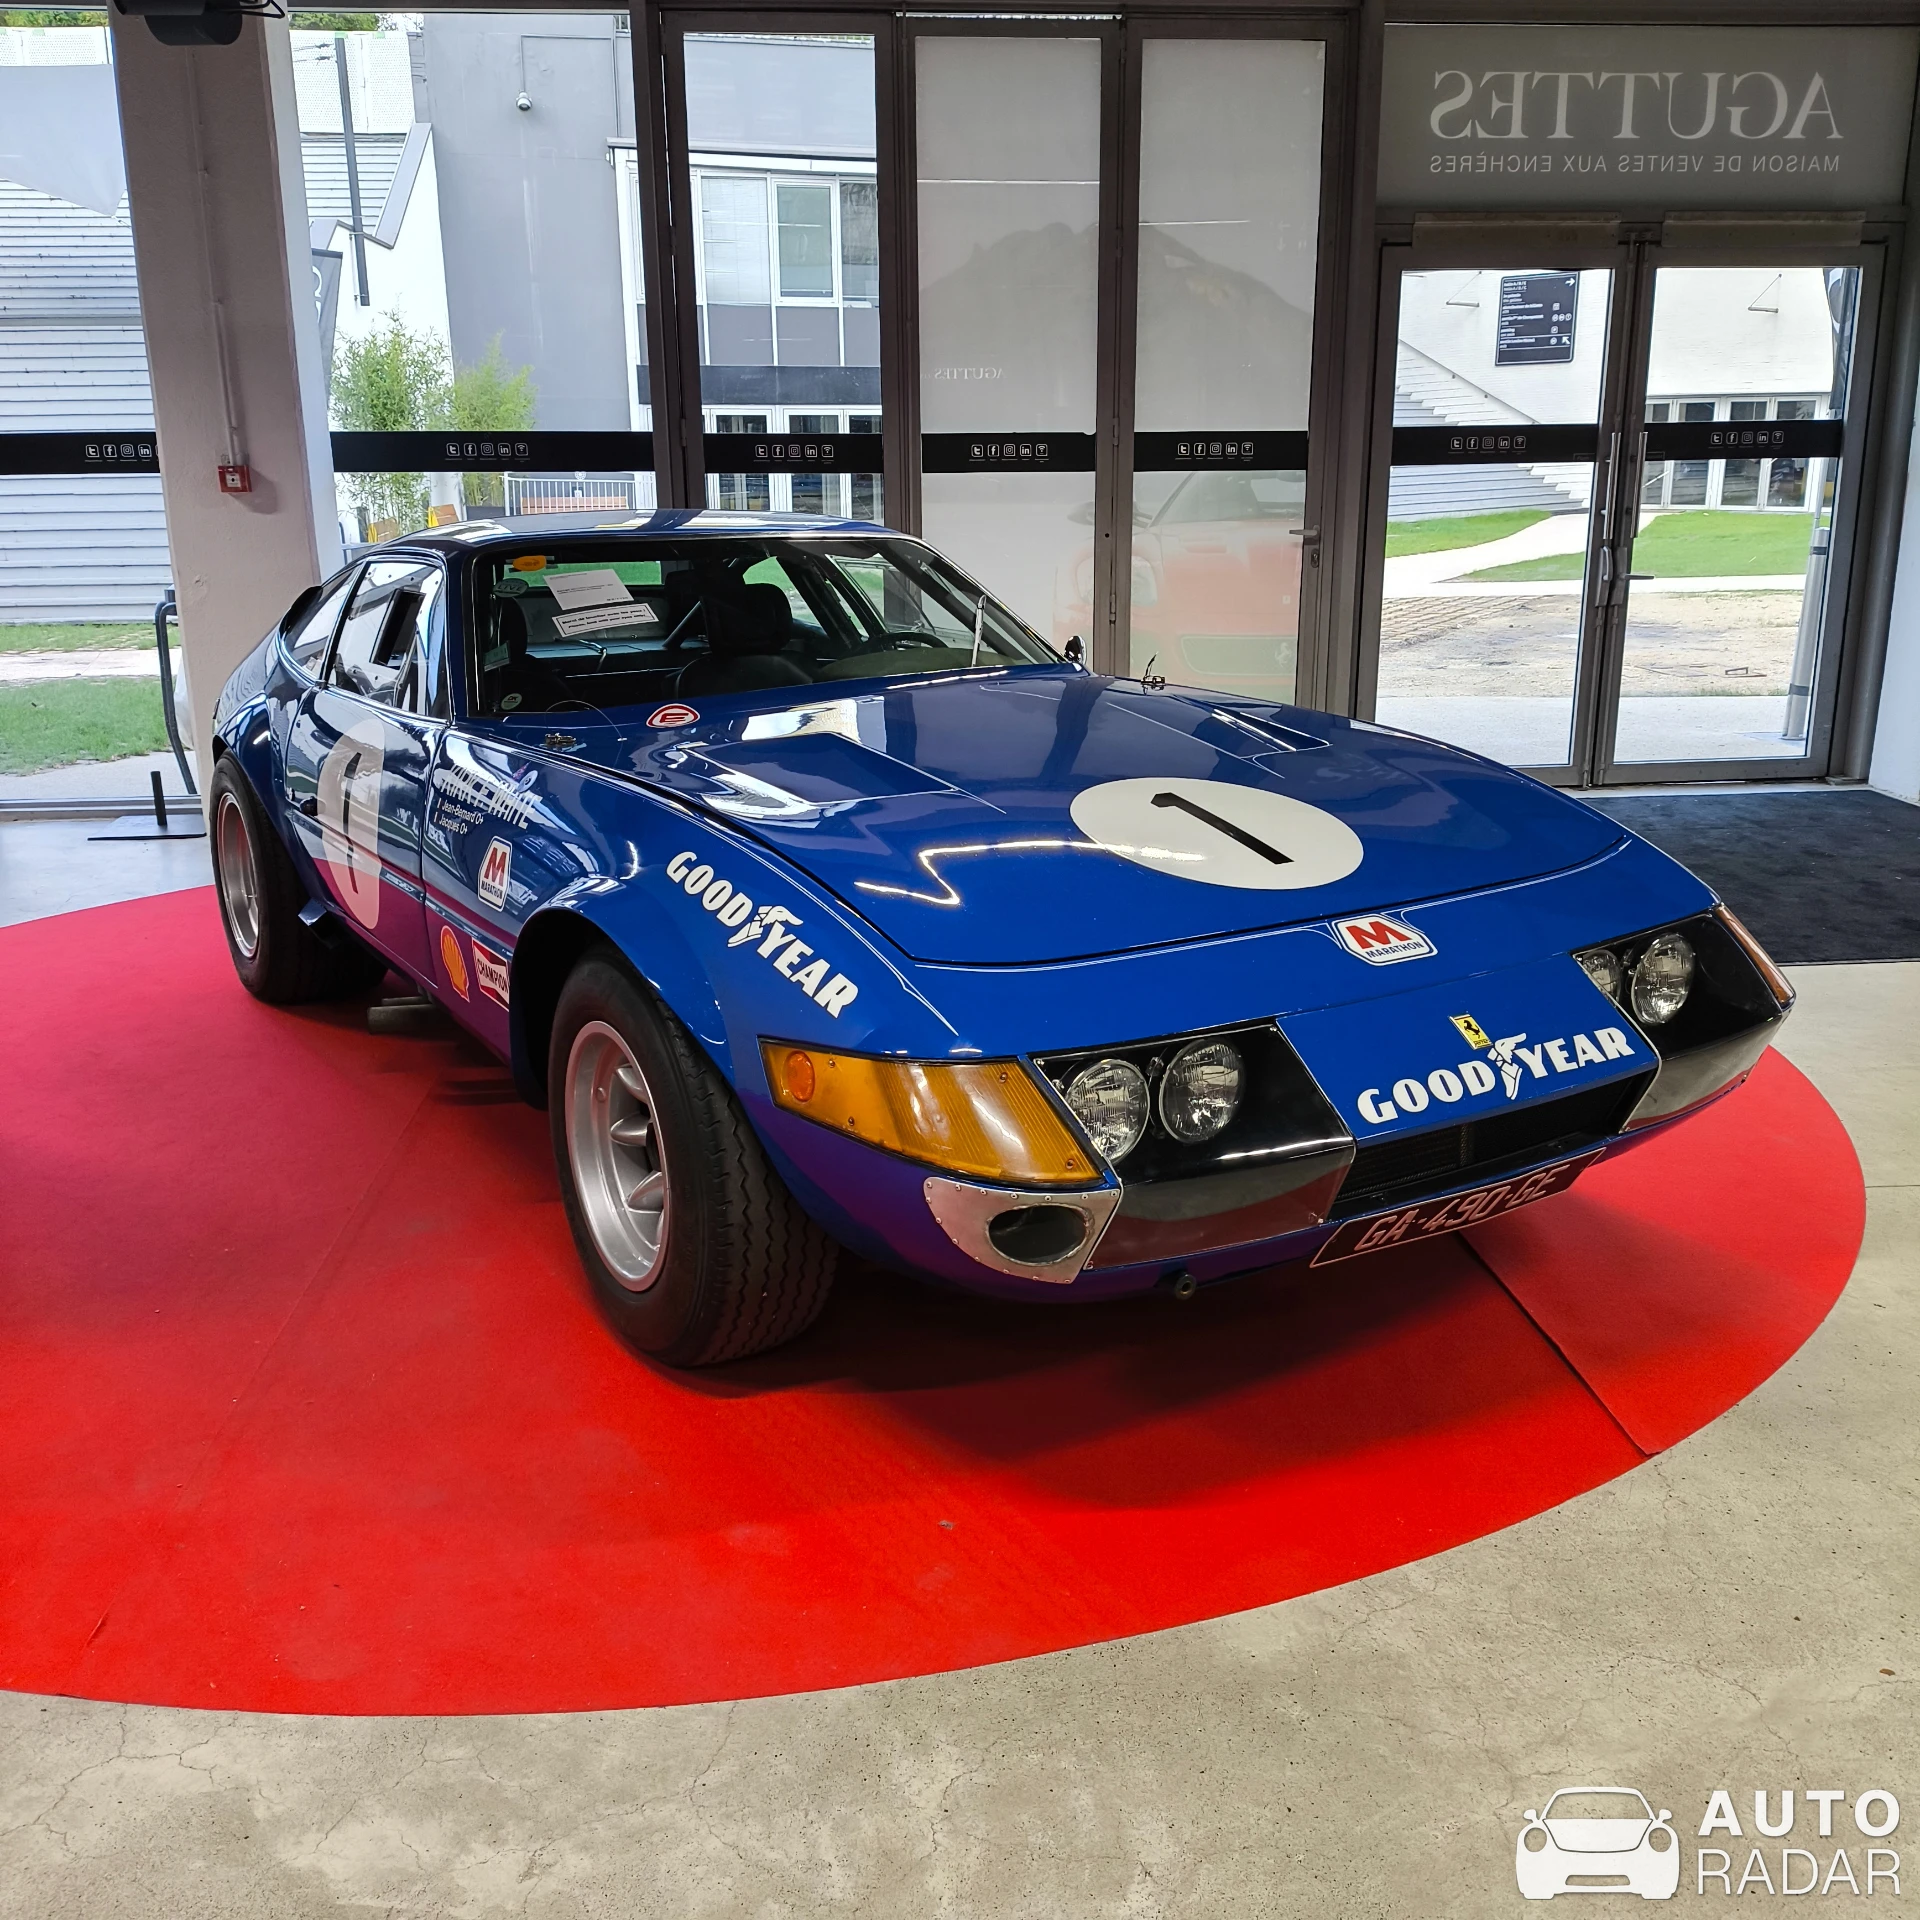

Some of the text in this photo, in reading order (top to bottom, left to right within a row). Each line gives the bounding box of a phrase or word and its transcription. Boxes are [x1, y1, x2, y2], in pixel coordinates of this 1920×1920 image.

[439, 813, 460, 832] Jacques
[1150, 792, 1295, 865] 1
[484, 847, 507, 887] M
[481, 880, 503, 900] MARATHON
[1345, 921, 1413, 949] M
[1365, 941, 1425, 959] MARATHON
[476, 958, 510, 994] CHAMPION
